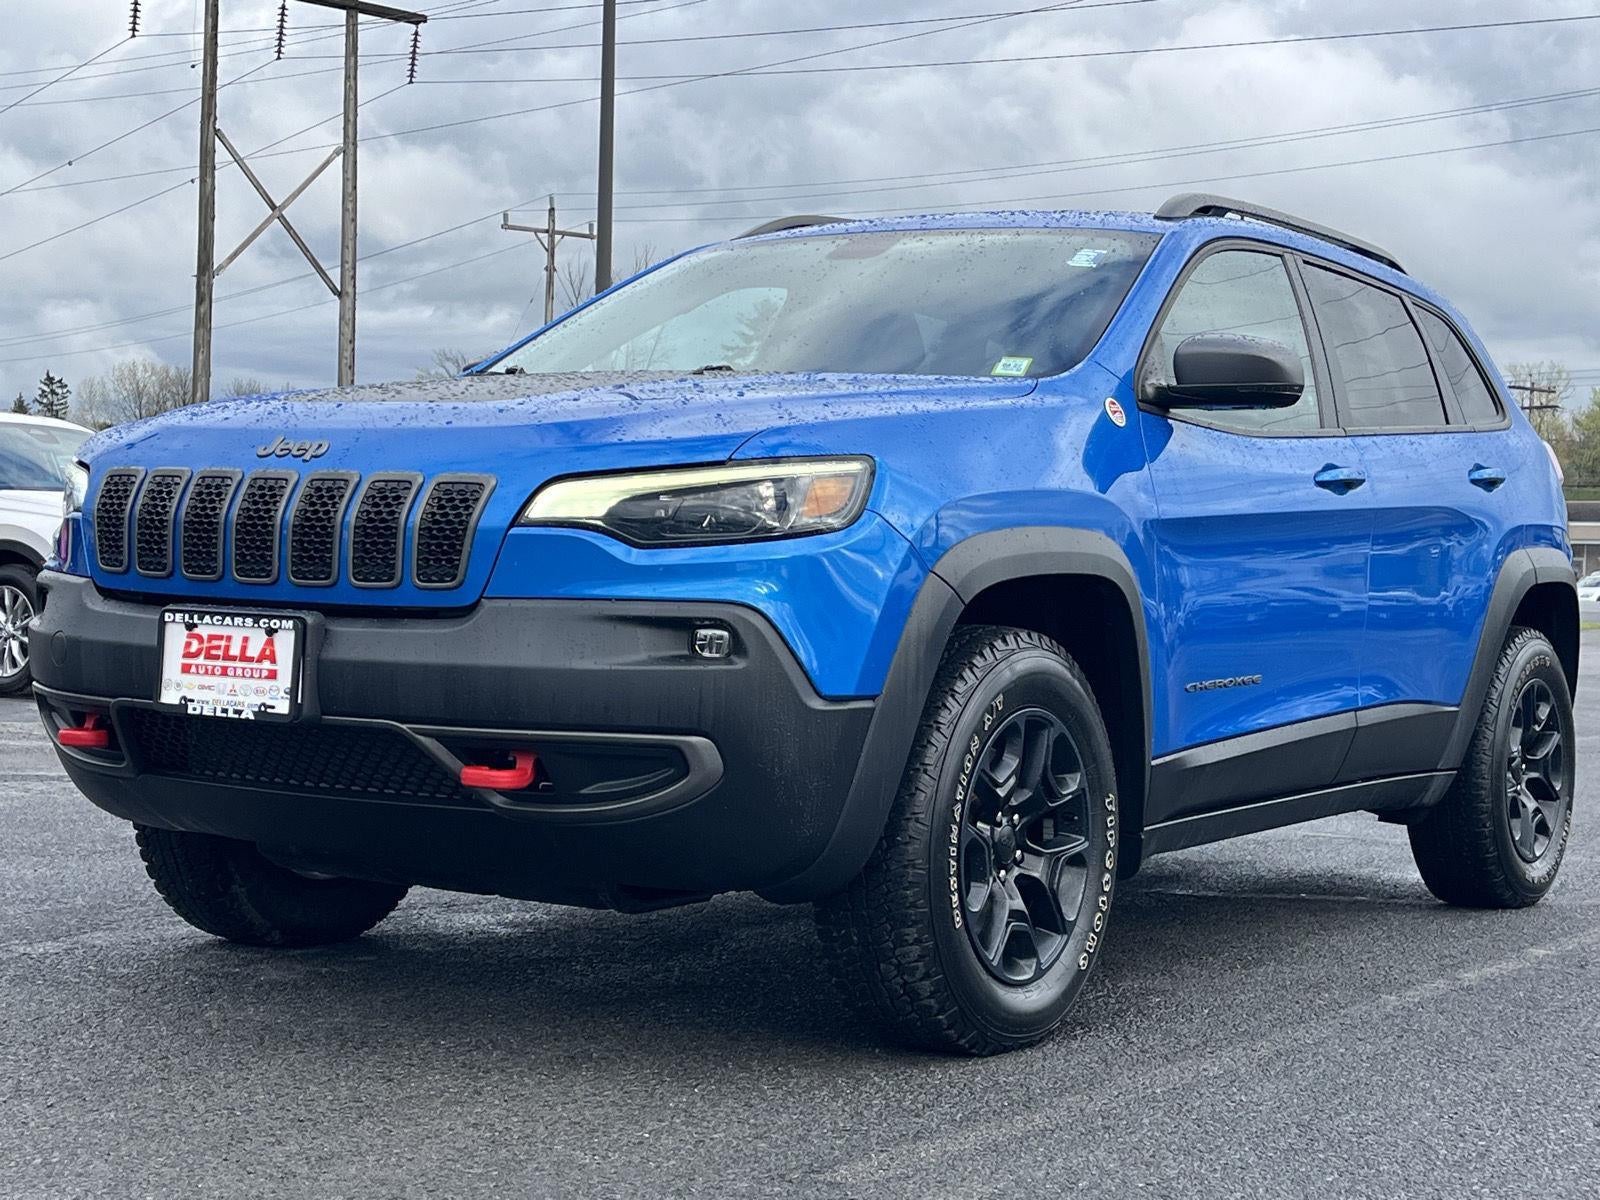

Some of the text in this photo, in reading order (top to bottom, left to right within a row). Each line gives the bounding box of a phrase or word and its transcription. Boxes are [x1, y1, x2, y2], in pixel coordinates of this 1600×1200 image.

[256, 435, 330, 463] Jeep
[164, 612, 294, 629] DELLACARS.COM
[182, 631, 277, 665] DELLA
[189, 664, 269, 679] AUTO GROUP
[1184, 674, 1262, 693] CHEROKEE
[187, 703, 255, 720] DELLA
